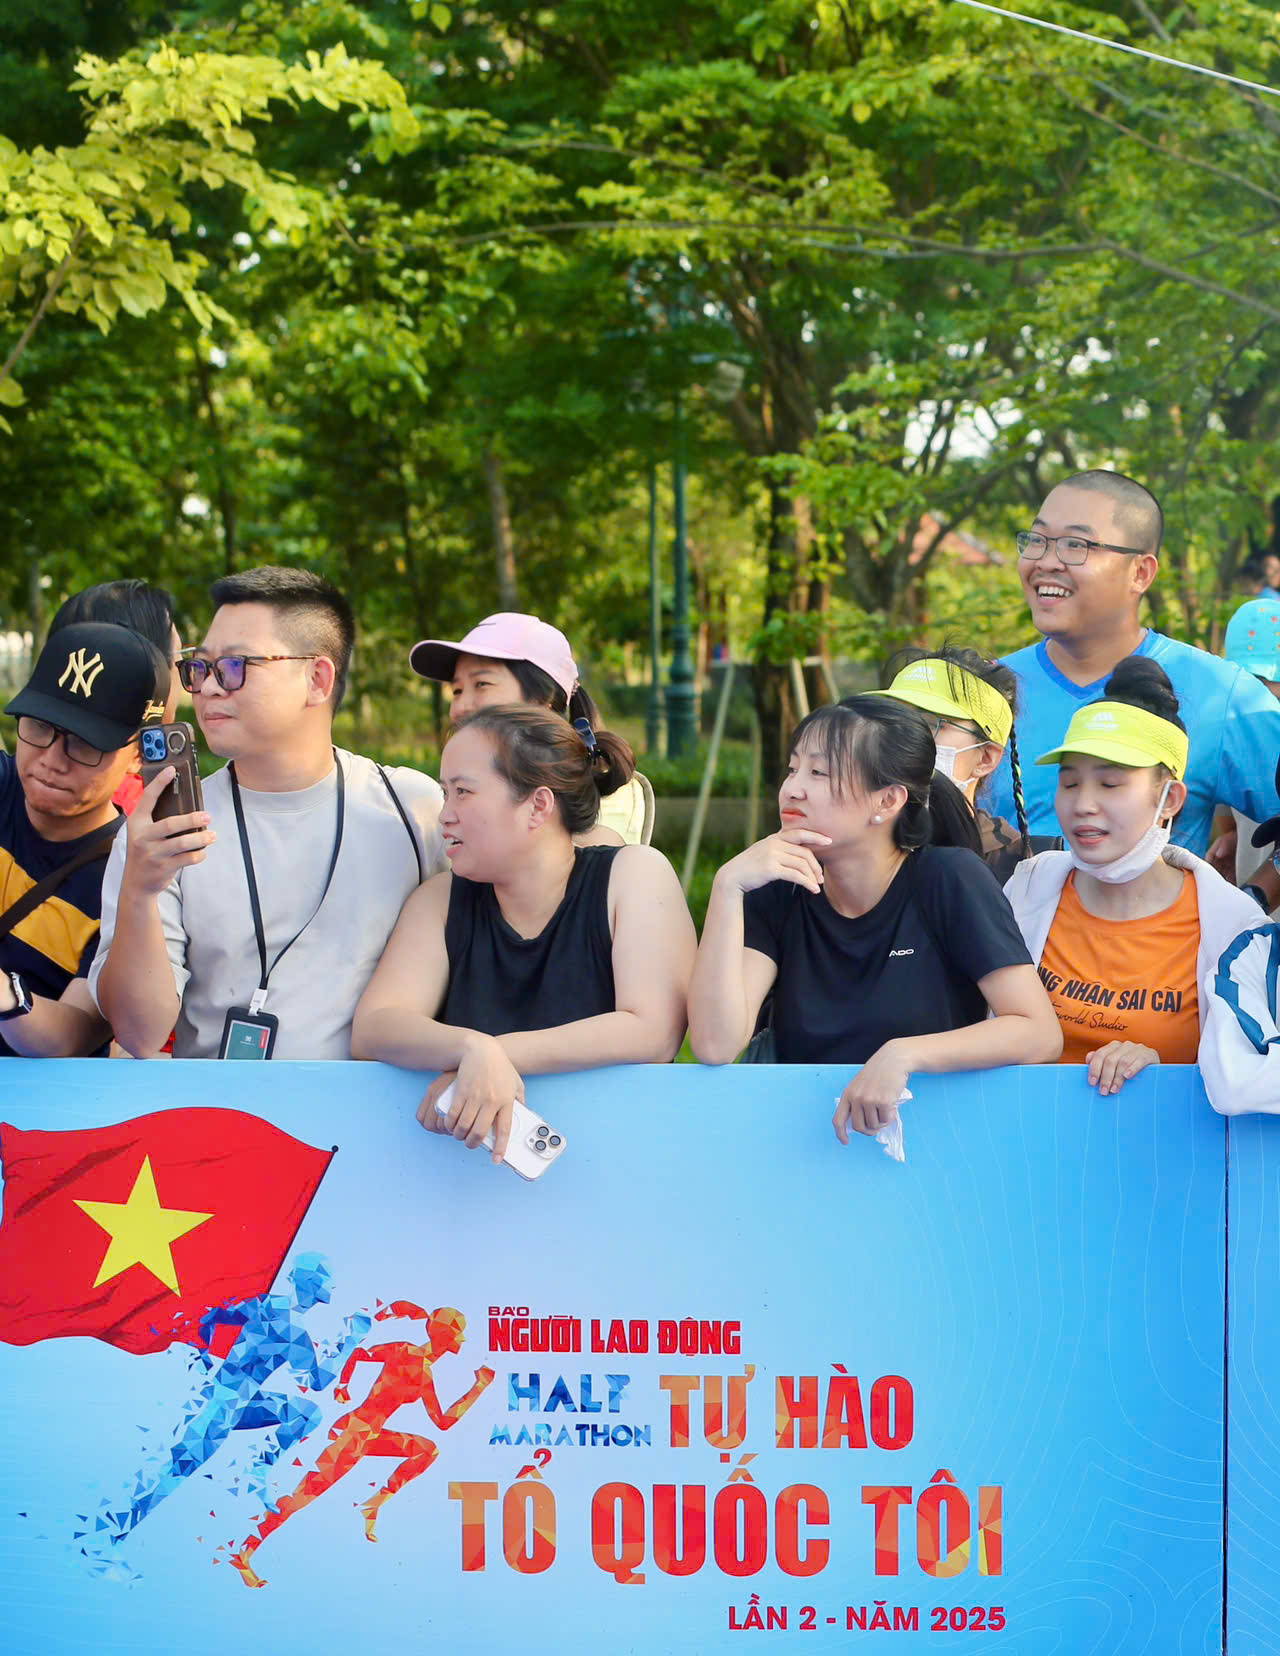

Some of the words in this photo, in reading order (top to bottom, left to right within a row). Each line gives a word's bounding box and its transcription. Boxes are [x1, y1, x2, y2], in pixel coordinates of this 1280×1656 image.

[58, 647, 104, 698] NY
[1060, 979, 1116, 1007] NHẬN
[1117, 989, 1147, 1010] SAI
[1151, 986, 1183, 1012] CÃI
[1089, 1012, 1129, 1032] Studio
[488, 1315, 582, 1353] NGƯỜI
[591, 1319, 649, 1354] LAO
[657, 1317, 741, 1357] ĐỘNG
[508, 1373, 631, 1413] HALF
[659, 1364, 756, 1463] TỰ
[775, 1363, 915, 1450] HÀO
[489, 1423, 652, 1447] MARATHON
[447, 1448, 556, 1574] TỔ
[591, 1453, 830, 1584] QUỐC
[861, 1468, 1003, 1578] TÔI
[728, 1593, 787, 1631] LẦN
[799, 1607, 817, 1631] 2
[846, 1600, 919, 1631] NĂM
[930, 1606, 1006, 1632] 2025
